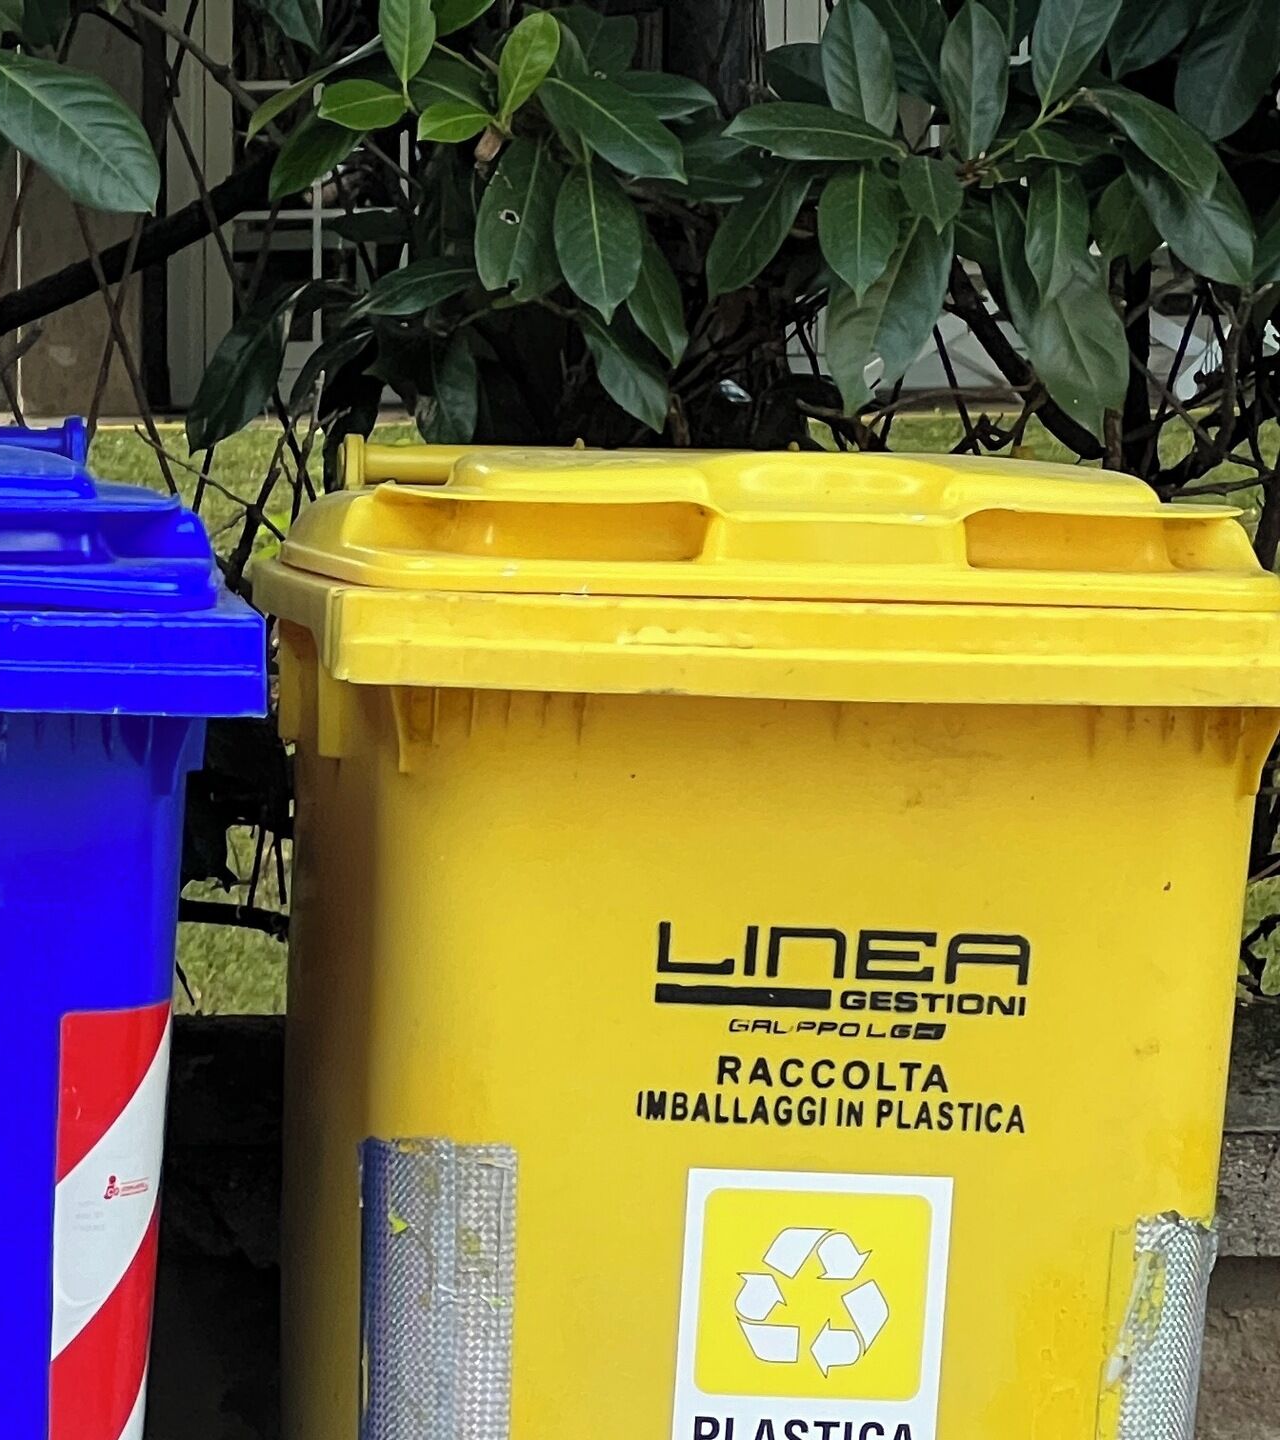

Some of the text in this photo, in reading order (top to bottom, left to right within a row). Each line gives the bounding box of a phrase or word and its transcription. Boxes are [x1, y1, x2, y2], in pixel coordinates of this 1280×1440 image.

[656, 921, 1031, 985] LINEA
[840, 990, 1026, 1016] GESTIONI
[716, 1055, 950, 1093] RACCOLTA
[636, 1090, 1026, 1134] IMBALLAGGI IN PLASTICA
